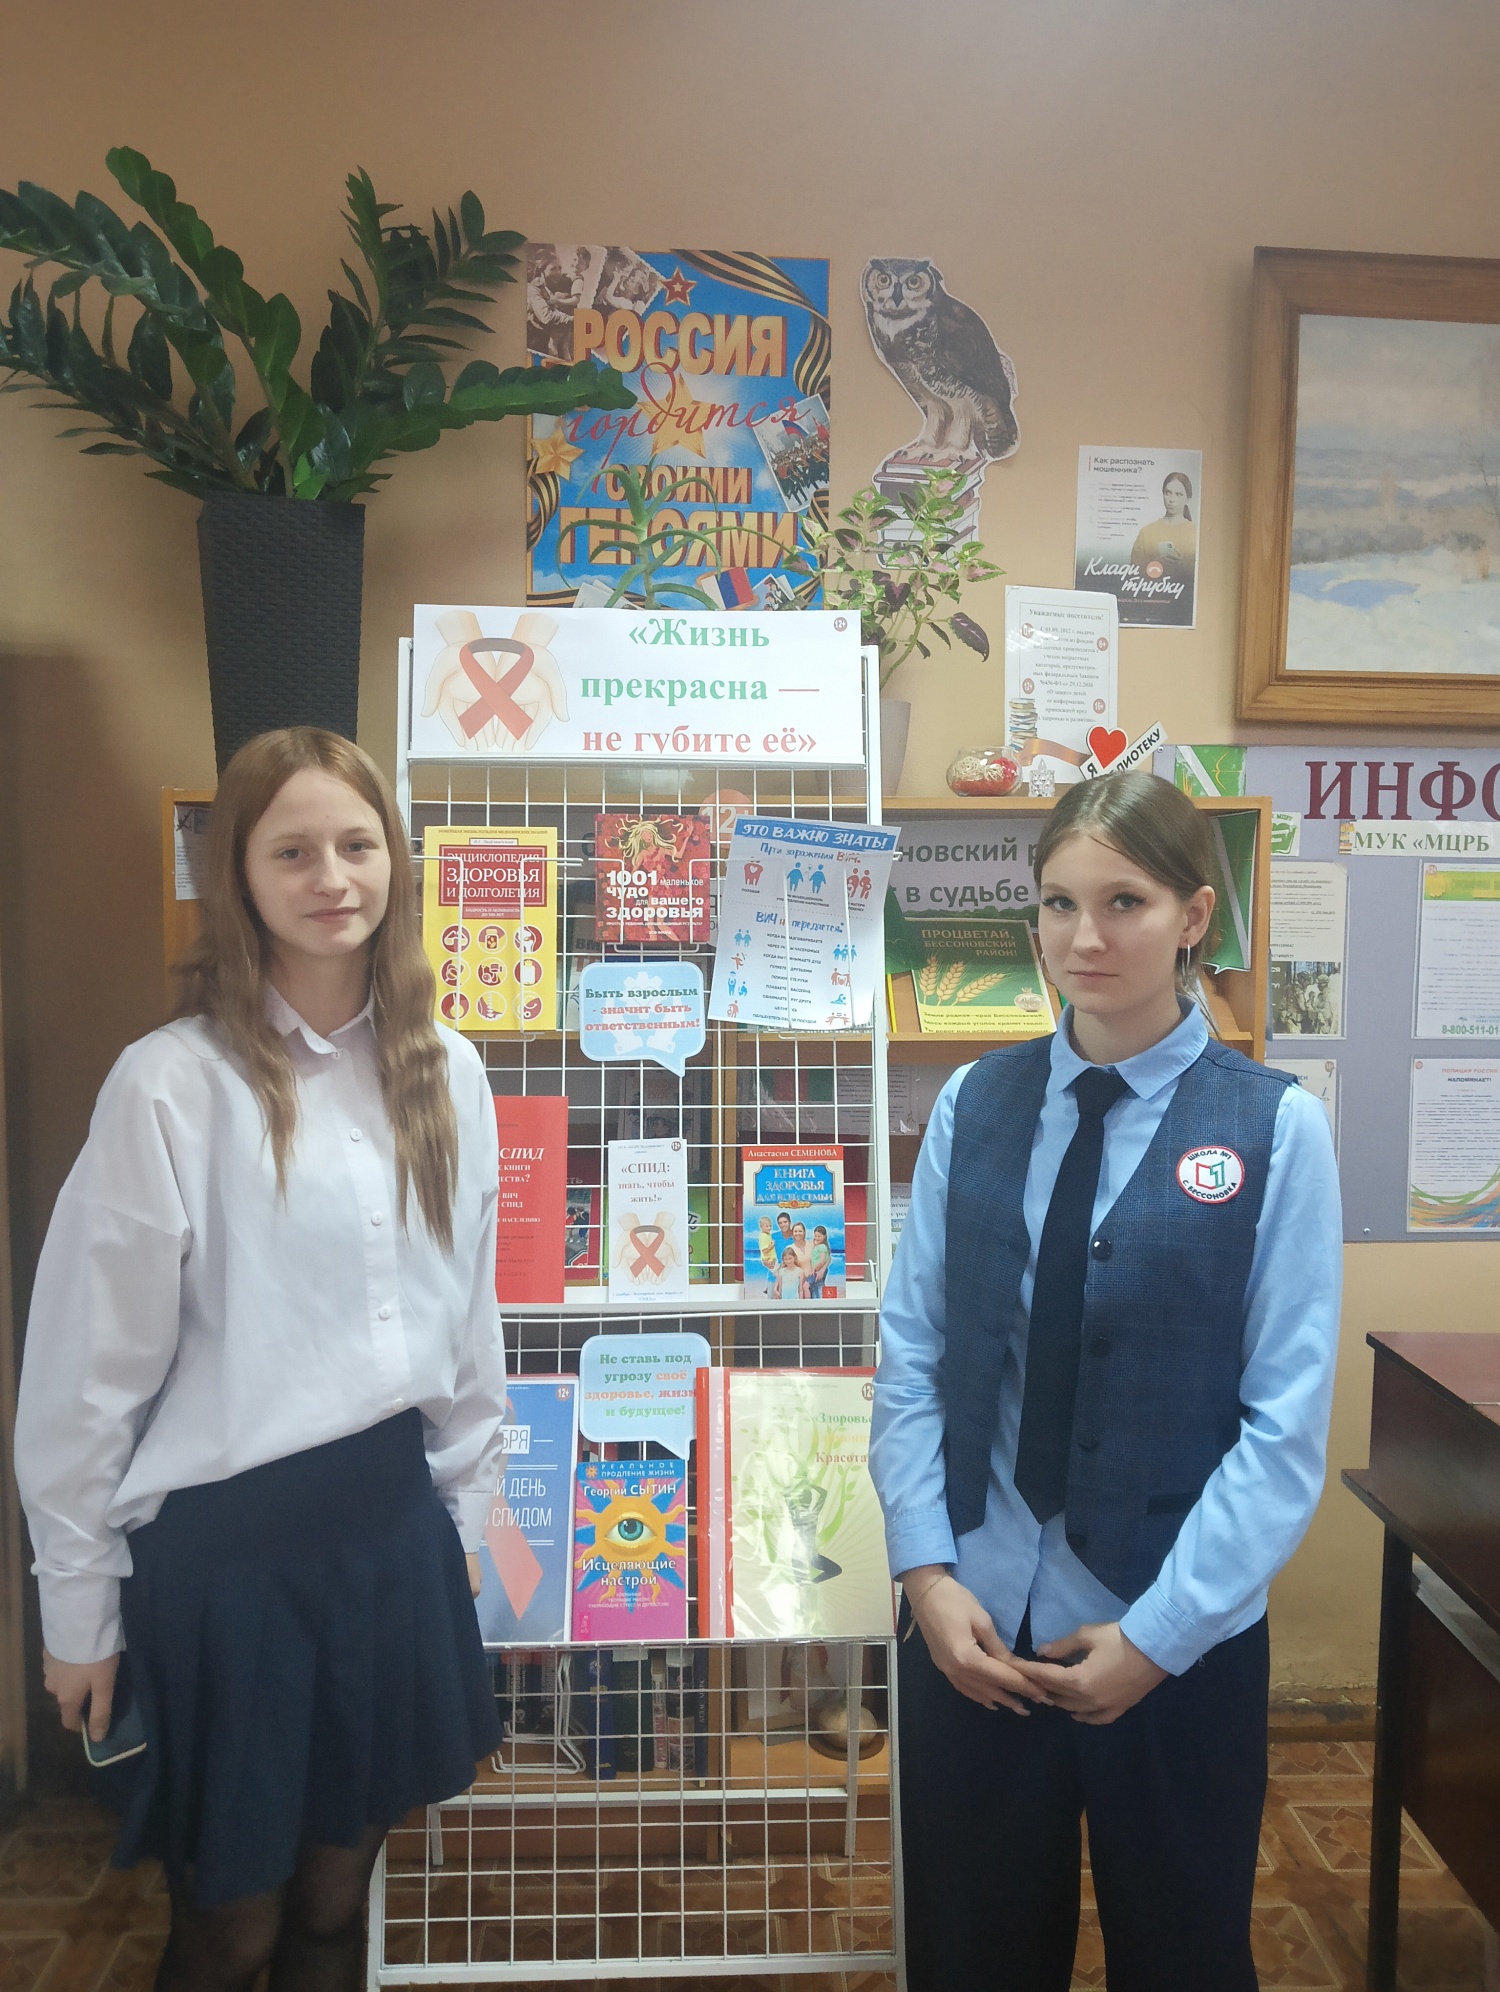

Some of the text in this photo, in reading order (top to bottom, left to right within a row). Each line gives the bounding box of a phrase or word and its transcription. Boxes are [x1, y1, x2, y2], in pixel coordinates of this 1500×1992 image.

[573, 308, 787, 377] РОССИЯ
[1110, 458, 1154, 466] распознать
[1094, 466, 1142, 474] мошенника?
[1084, 557, 1139, 582] Клади
[1121, 576, 1185, 600] трубку
[1030, 609, 1104, 620] Уважаемые посетители!
[628, 618, 847, 647] «Жизнь 12+
[580, 676, 768, 706] прекрасна
[583, 725, 818, 754] не губите её»
[1087, 762, 1098, 778] Я
[742, 824, 888, 850] ЭТО ВАЖНО ЗНАТЬ!
[1354, 832, 1490, 852] МУК «МЦРБ
[760, 842, 834, 860] Пути заражения
[897, 836, 1018, 862] новский
[446, 868, 540, 884] ЗДОРОВЬЯ
[606, 870, 704, 886] 1001 маленькое
[446, 888, 540, 899] И ДОЛГОЛЕТИЯ
[606, 886, 648, 900] чудо
[930, 878, 1029, 908] судьбе
[606, 907, 704, 921] здоровья
[756, 911, 778, 924] ВИЧ
[924, 940, 1016, 948] БЕССОНОВСКИЙ
[585, 988, 698, 999] Быть взрослым
[600, 1006, 650, 1014] значит
[654, 1004, 692, 1013] быть
[585, 1018, 700, 1031] ответственным!
[500, 1148, 544, 1162] СПИД
[1188, 1150, 1218, 1161] ШКОЛА
[621, 1162, 670, 1174] «СПИД:
[774, 1168, 816, 1178] КНИГА
[646, 1180, 674, 1188] чтобы
[766, 1181, 825, 1192] ЗДОРОВЬЯ
[1188, 1182, 1238, 1200] БЕССОНОВКА
[600, 1354, 692, 1364] Не ставь под
[604, 1370, 687, 1384] угрозу своё
[558, 1388, 570, 1398] 12+
[585, 1391, 654, 1400] здоровье,
[606, 1405, 686, 1418] и будущее!
[816, 1452, 867, 1465] Красота
[508, 1478, 546, 1500] ДЕНЬ
[584, 1484, 676, 1498] Георгий СЫТИН
[492, 1507, 552, 1530] СПИДОМ
[582, 1558, 676, 1573] Исцеляющие
